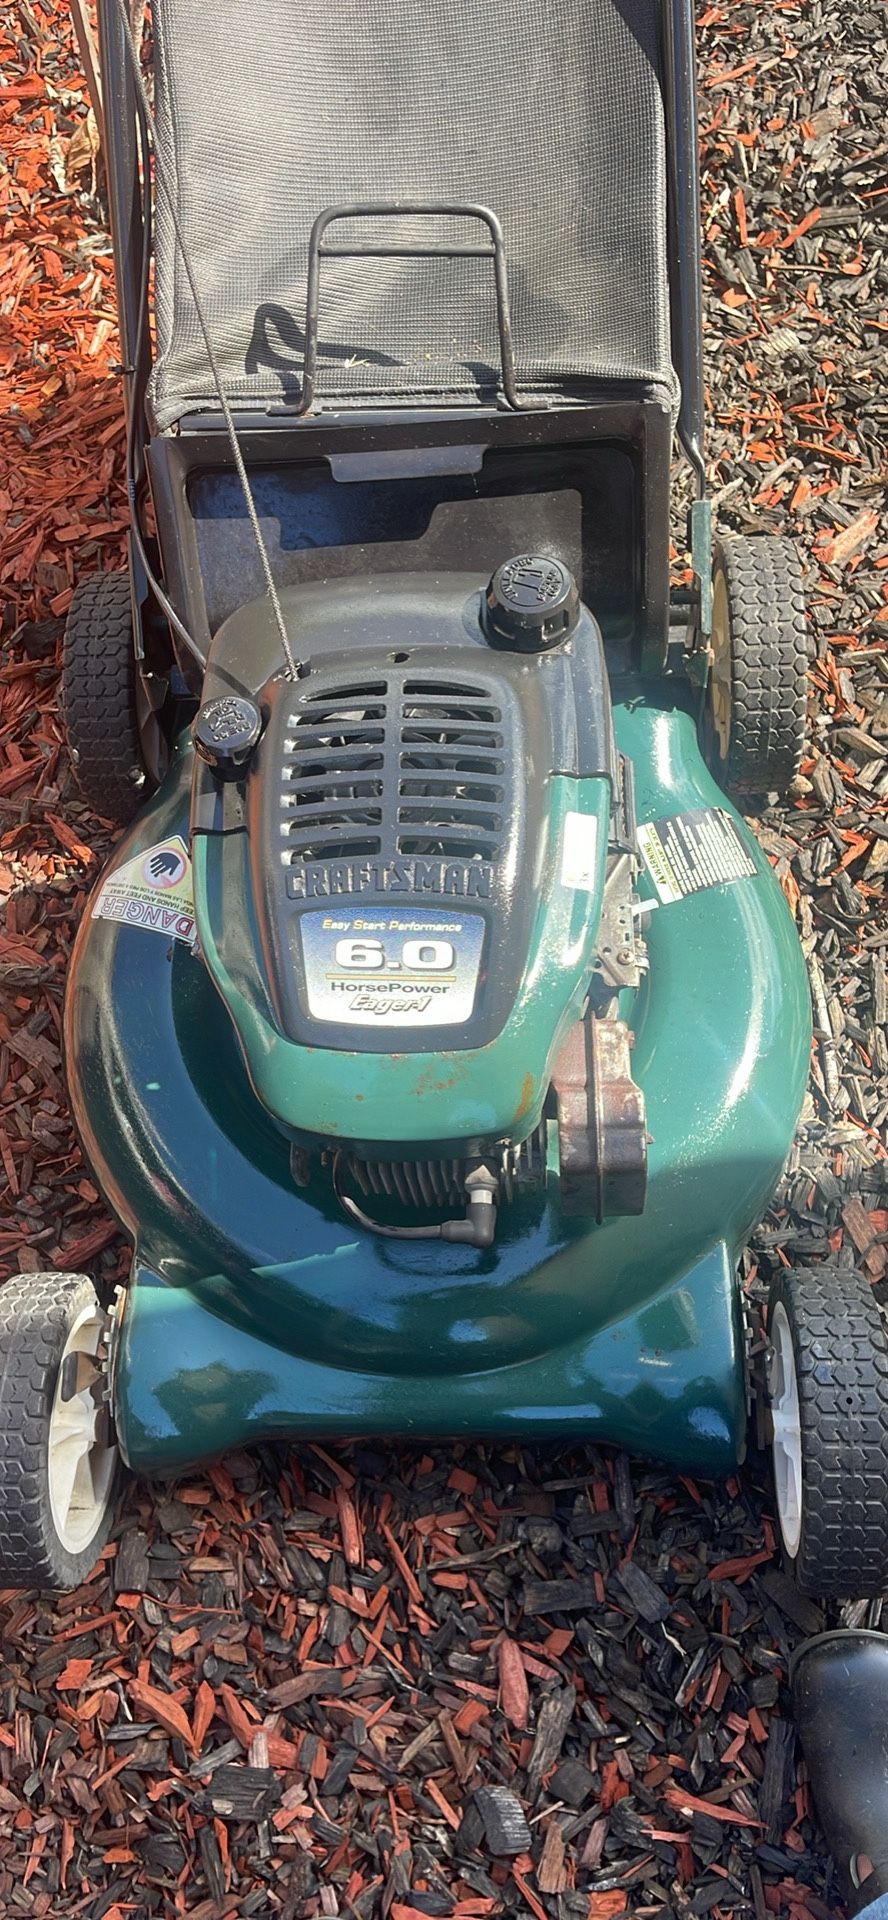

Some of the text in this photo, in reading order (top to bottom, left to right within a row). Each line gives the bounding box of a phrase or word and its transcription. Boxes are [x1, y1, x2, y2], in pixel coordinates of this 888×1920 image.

[642, 842, 662, 876] WARNING
[285, 861, 492, 900] CRAFTSMAN
[126, 890, 142, 899] FEET
[141, 894, 156, 902] AND
[156, 898, 180, 909] HANDS
[100, 897, 195, 936] DANGER
[322, 918, 463, 933] Easy Start Performance
[335, 938, 456, 972] 6.0
[331, 981, 450, 994] HorsePower
